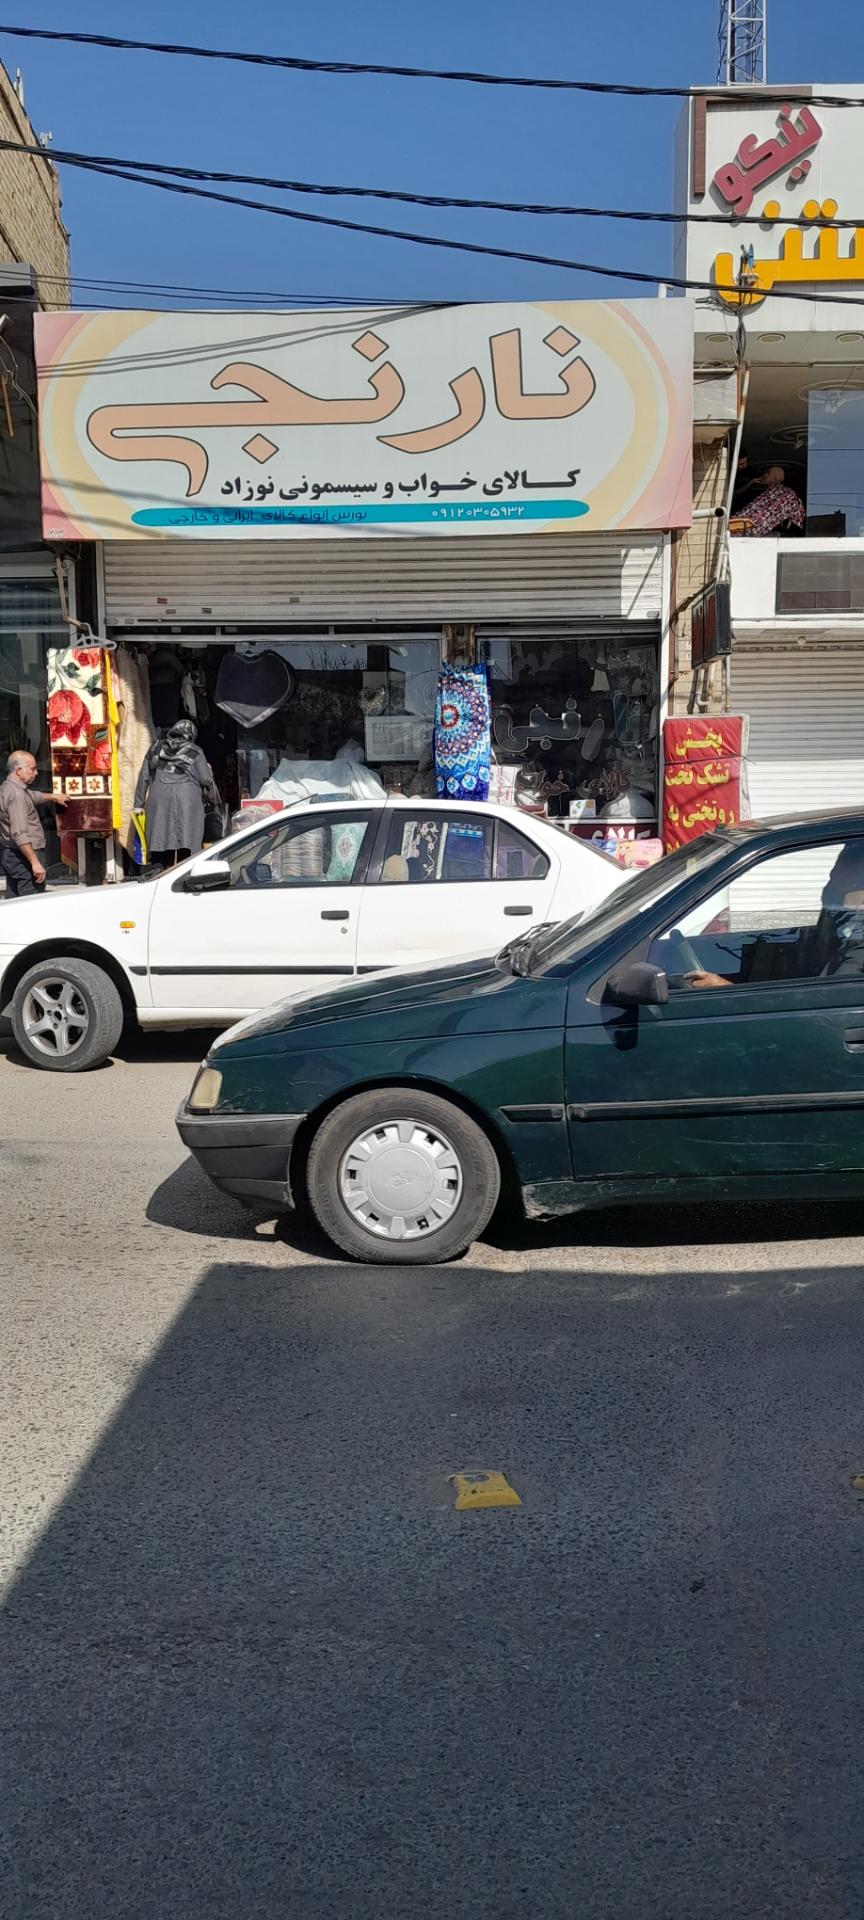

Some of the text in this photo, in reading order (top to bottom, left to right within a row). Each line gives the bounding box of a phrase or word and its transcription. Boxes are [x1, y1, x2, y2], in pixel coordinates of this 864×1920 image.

[714, 199, 864, 305] تنی
[86, 325, 596, 497] نارنجی
[220, 469, 581, 501] کالای خواب و سیسمونی نوزاد
[676, 727, 723, 756] پخش
[697, 763, 731, 785] تشک
